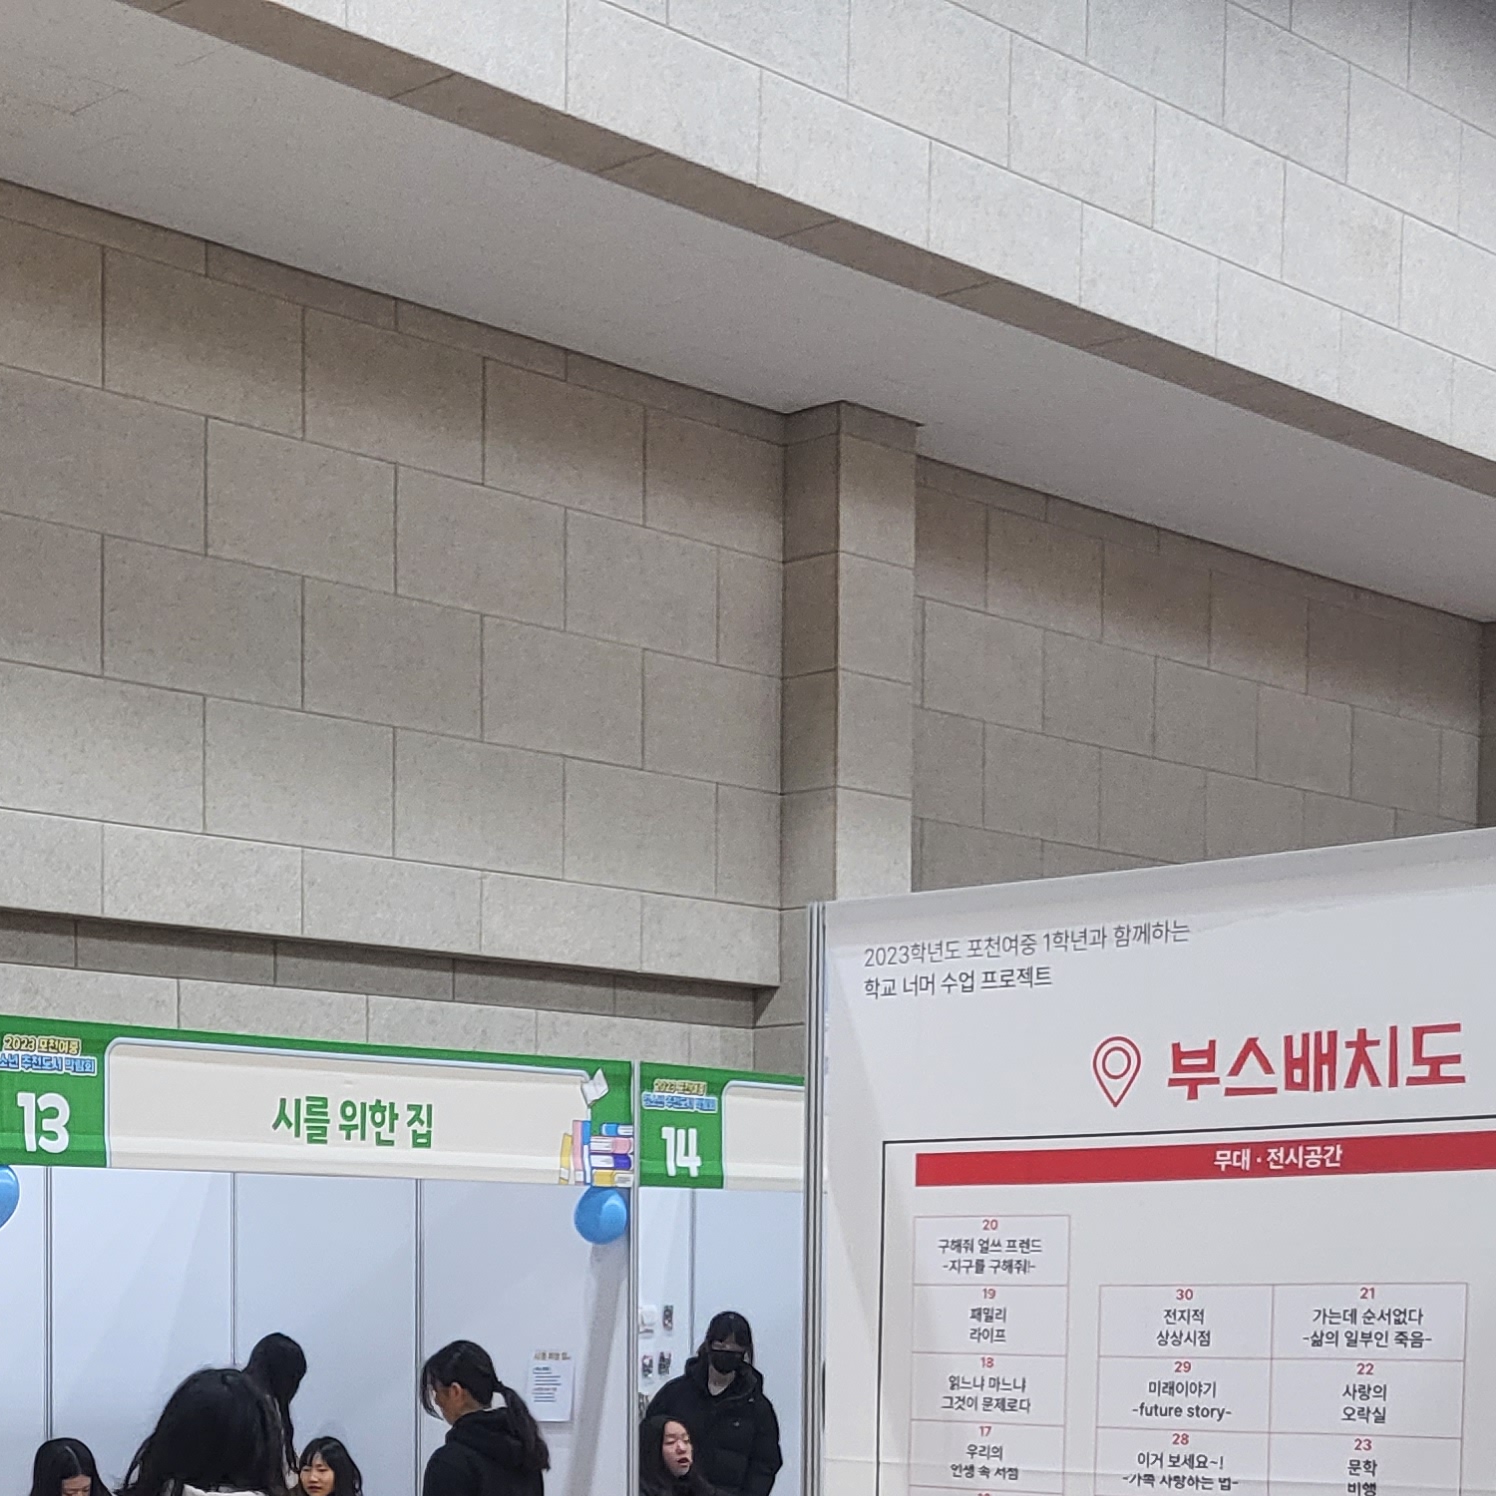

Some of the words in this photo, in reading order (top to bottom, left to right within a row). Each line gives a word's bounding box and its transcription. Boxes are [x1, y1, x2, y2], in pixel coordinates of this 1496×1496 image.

[864, 939, 961, 967] 2023학년도
[967, 934, 1037, 959] 포천여중
[1043, 926, 1107, 953] 1학년과
[1113, 920, 1190, 948] 함께하는
[864, 977, 897, 999] 학교
[903, 973, 935, 996] 너머
[940, 971, 975, 994] 수업
[981, 965, 1052, 990] 프로젝트
[1167, 1022, 1466, 1100] 부스배치도
[17, 1092, 70, 1153] 13
[272, 1095, 331, 1144] 시를
[339, 1099, 399, 1146] 위한
[406, 1103, 433, 1149] 집
[661, 1127, 702, 1177] 14
[1213, 1148, 1251, 1171] 무대
[1266, 1144, 1343, 1169] 전시공간
[982, 1219, 998, 1231] 20
[938, 1239, 974, 1254] 구해줘
[978, 1238, 1002, 1254] 얼쓰
[1005, 1239, 1042, 1254] 프렌드
[983, 1288, 996, 1299] 19
[1176, 1288, 1194, 1301] 30
[1360, 1287, 1375, 1299] 21
[970, 1307, 1006, 1323] 패밀리
[1164, 1308, 1205, 1325] 전지적
[1313, 1308, 1357, 1325] 가는데
[1362, 1308, 1423, 1325] 순서없다
[970, 1328, 1006, 1343] 라이프
[1156, 1330, 1211, 1347] 상상시점
[1344, 1330, 1388, 1348] 일부인
[981, 1357, 994, 1368] 18
[1174, 1361, 1192, 1373] 29
[1357, 1363, 1374, 1375] 22
[1148, 1380, 1217, 1398] 미래이야기
[1342, 1383, 1387, 1401] 사랑의
[941, 1396, 978, 1411] 그것이
[982, 1397, 1031, 1413] 문제로다
[1342, 1406, 1386, 1424] 오락실
[980, 1426, 992, 1437] 17
[1172, 1433, 1190, 1445] 28
[966, 1444, 1003, 1461] 우리의
[1354, 1438, 1372, 1451] 23
[1138, 1452, 1163, 1469] 이거
[1347, 1459, 1377, 1477] 문학
[978, 1465, 990, 1478] 속
[1160, 1474, 1214, 1491] 사랑하는
